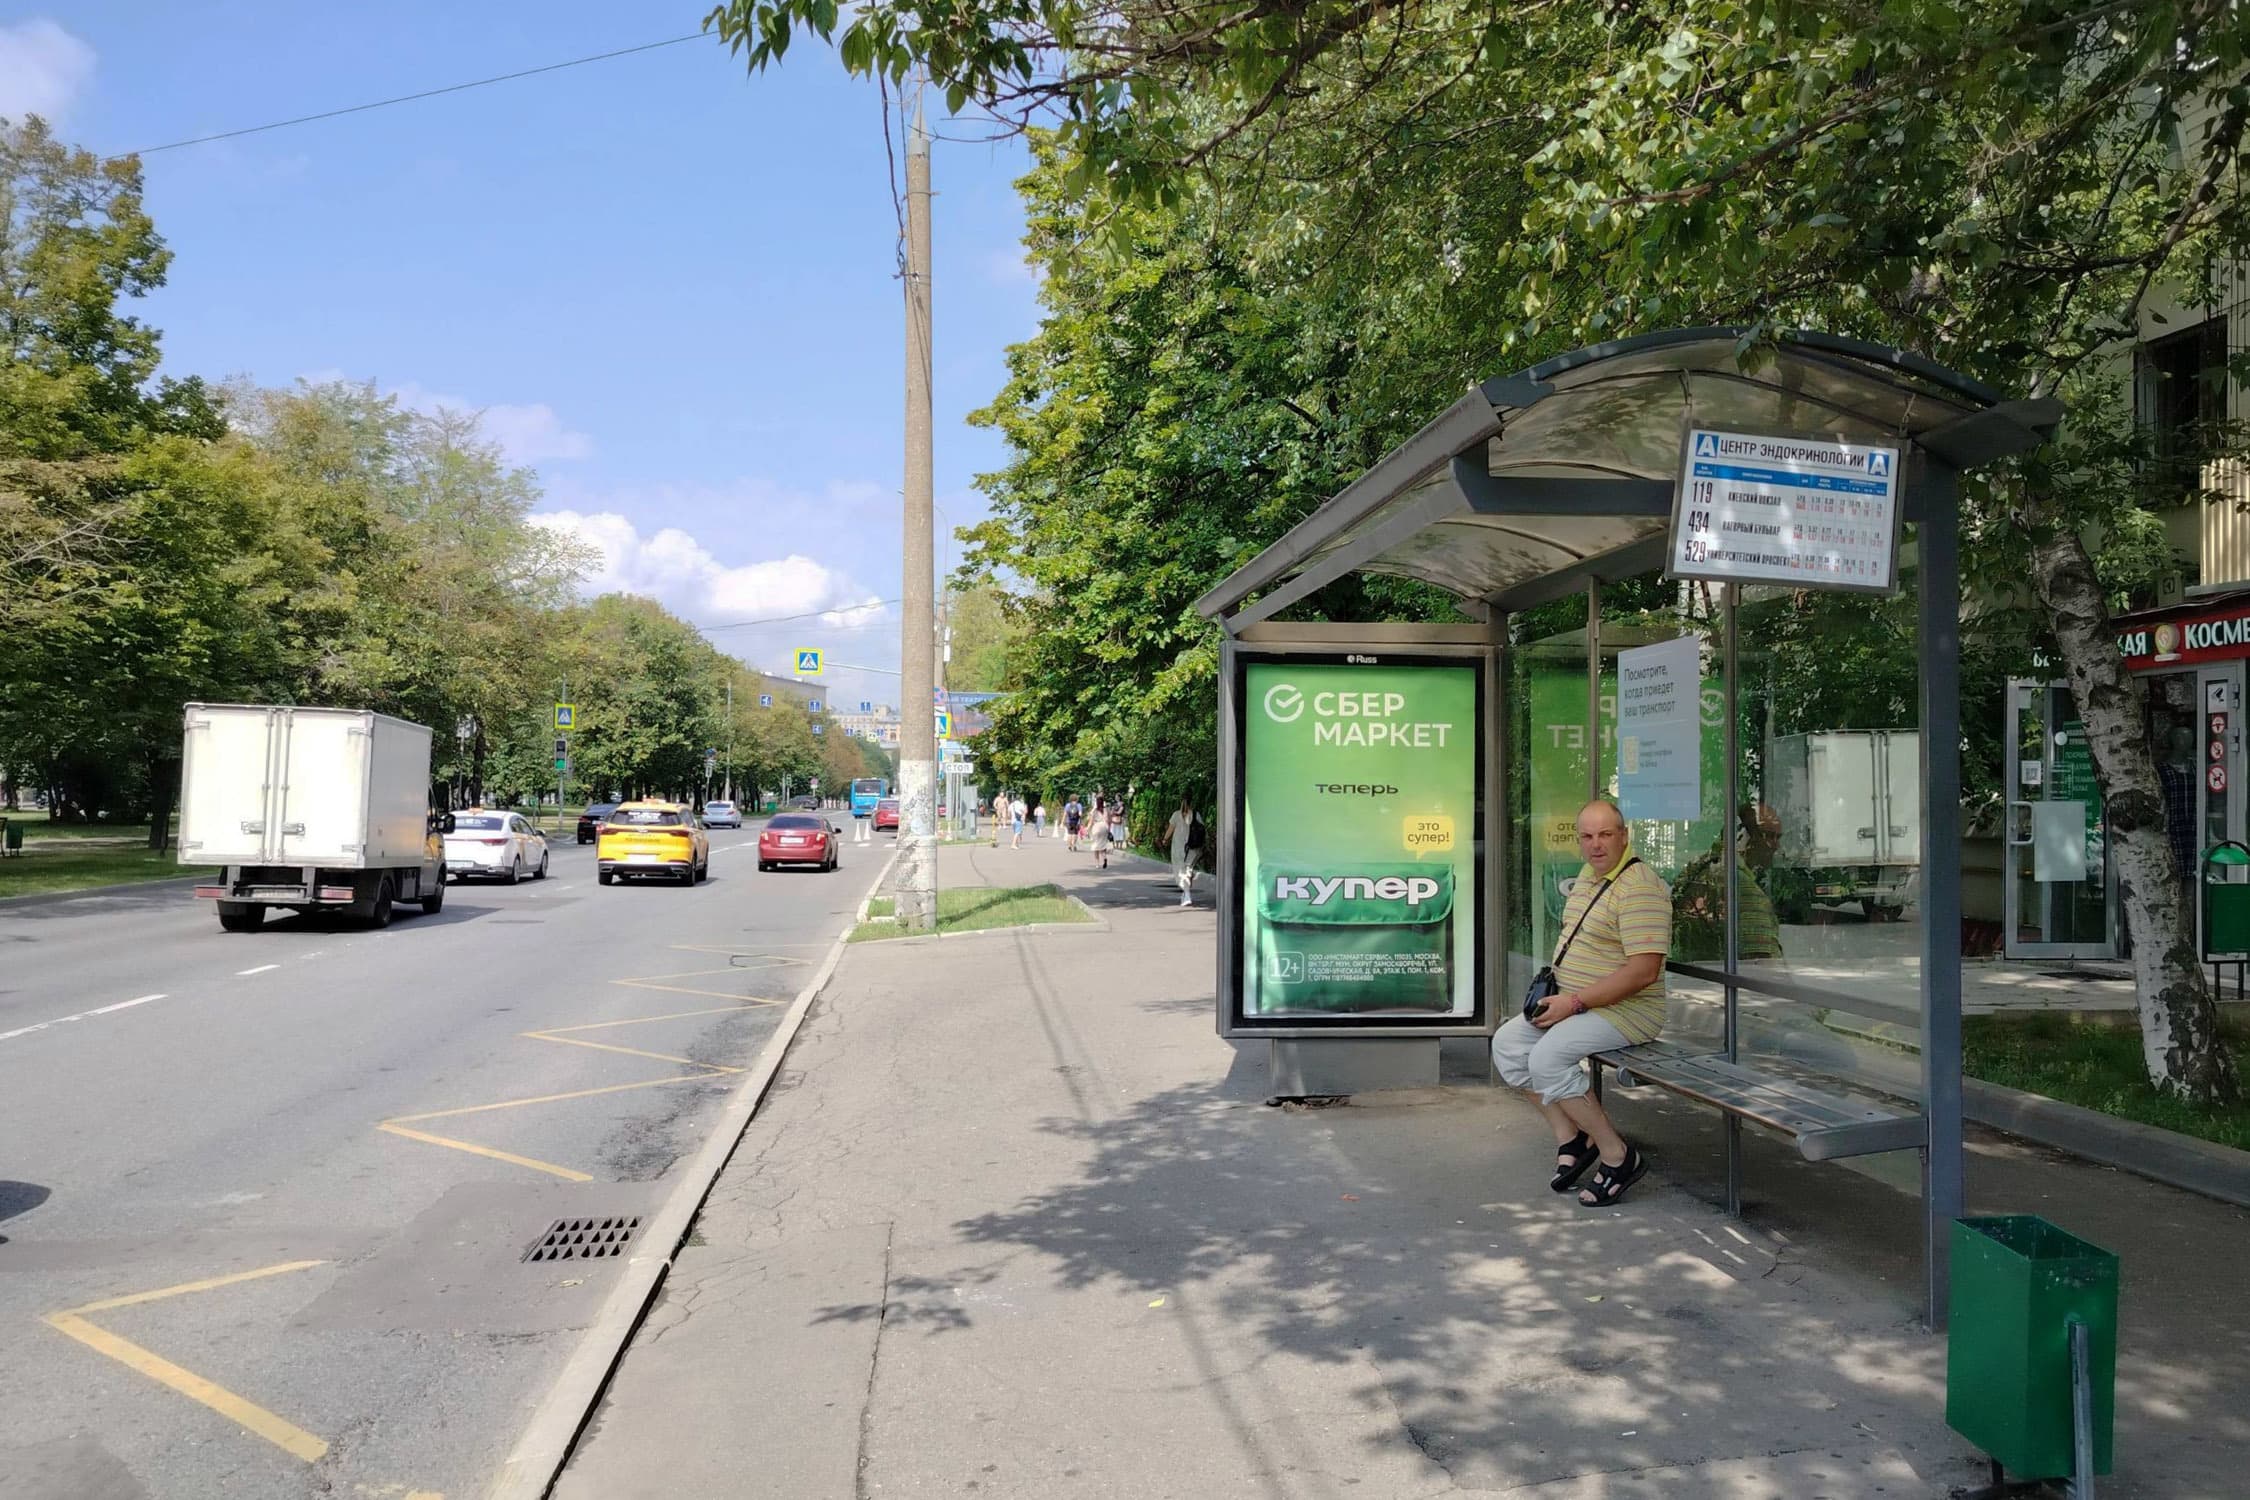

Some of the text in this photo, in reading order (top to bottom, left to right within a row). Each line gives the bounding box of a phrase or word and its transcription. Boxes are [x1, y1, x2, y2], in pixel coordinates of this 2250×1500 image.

[1720, 440, 1757, 455] ЦЕНТР
[1760, 443, 1864, 467] ЭНДОКРИНОЛОГИИ
[1693, 482, 1713, 503] 119
[1688, 510, 1709, 533] 434
[1685, 540, 1706, 563] 529
[1625, 665, 1668, 681] Посмотрите,
[1625, 682, 1674, 699] когда приедет
[1313, 692, 1405, 717] СБЕР
[1625, 706, 1638, 717] ваш
[1640, 701, 1676, 718] транспорт
[1314, 722, 1453, 748] МАРКЕТ
[1315, 784, 1399, 797] теперь
[1417, 822, 1440, 831] это
[1407, 832, 1450, 845] супер!
[1275, 876, 1440, 906] купер
[1271, 957, 1301, 977] 12+
